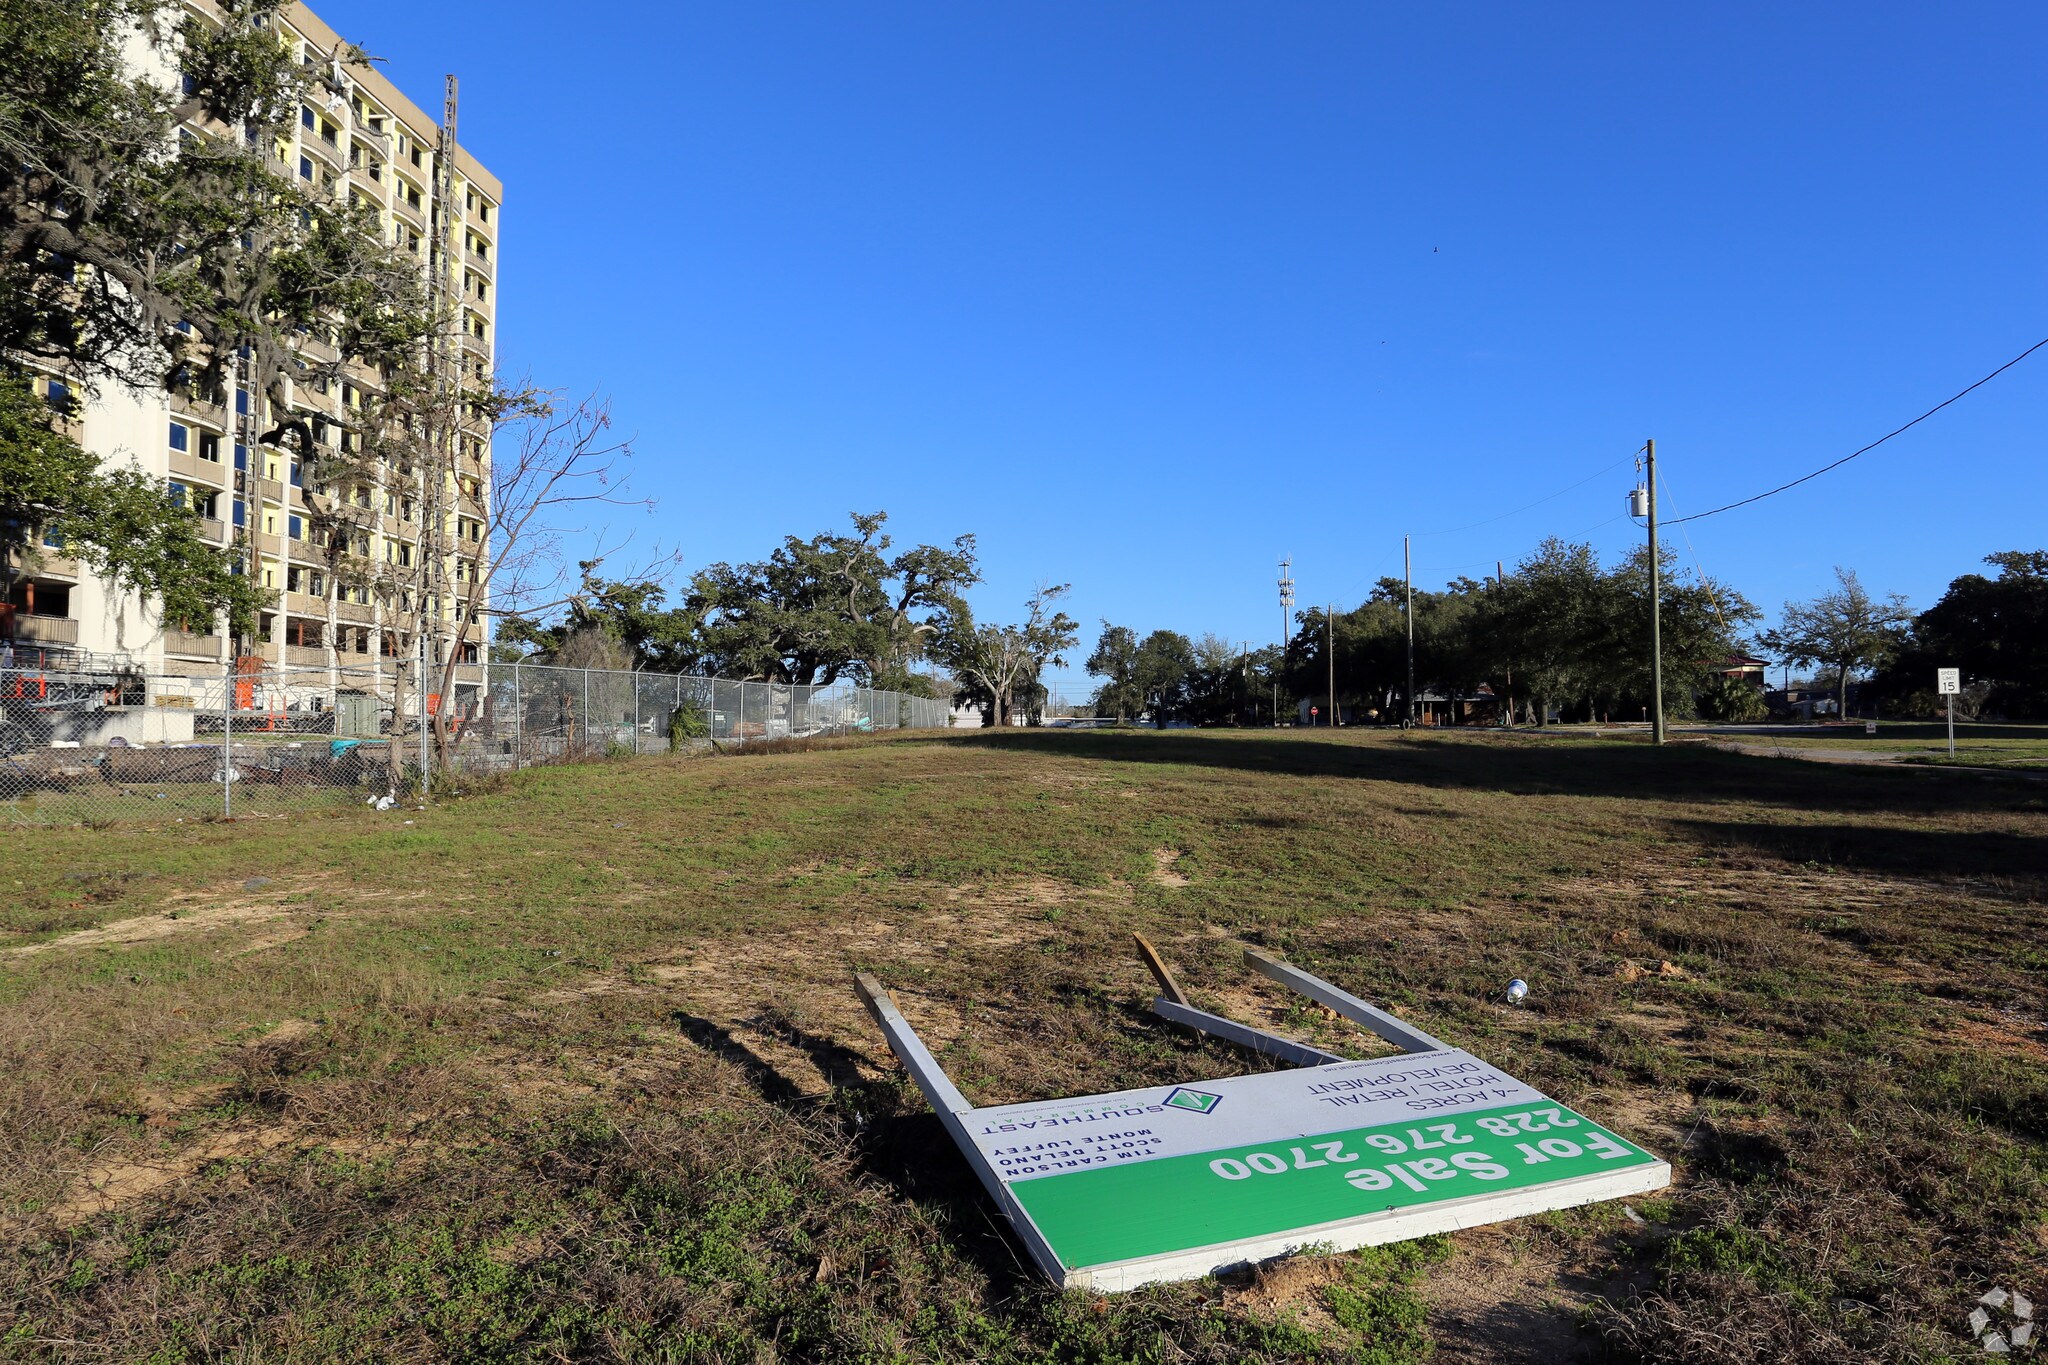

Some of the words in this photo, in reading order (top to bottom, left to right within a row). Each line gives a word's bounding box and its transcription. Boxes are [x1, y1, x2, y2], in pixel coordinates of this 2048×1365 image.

[1943, 682, 1955, 691] 15
[1307, 1062, 1480, 1095] DEVELOPMENT
[1419, 1074, 1501, 1092] HOTEL
[1319, 1088, 1408, 1107] RETAIL
[1410, 1085, 1419, 1095] /
[1405, 1091, 1488, 1111] ACRES
[981, 1105, 1164, 1135] SOUTHEAST
[988, 1102, 1144, 1125] COMMERCIAL
[1475, 1107, 1580, 1137] 228
[1081, 1129, 1152, 1144] MONTE
[1096, 1138, 1162, 1152] SCOTT
[1365, 1123, 1474, 1154] 276
[994, 1140, 1072, 1156] LUFFEY
[999, 1149, 1085, 1166] DELANO
[1117, 1148, 1156, 1159] TIM
[1514, 1131, 1634, 1165] For
[1005, 1156, 1107, 1176] CARLSON
[1209, 1141, 1360, 1180] 2700
[1344, 1152, 1510, 1192] Sale
